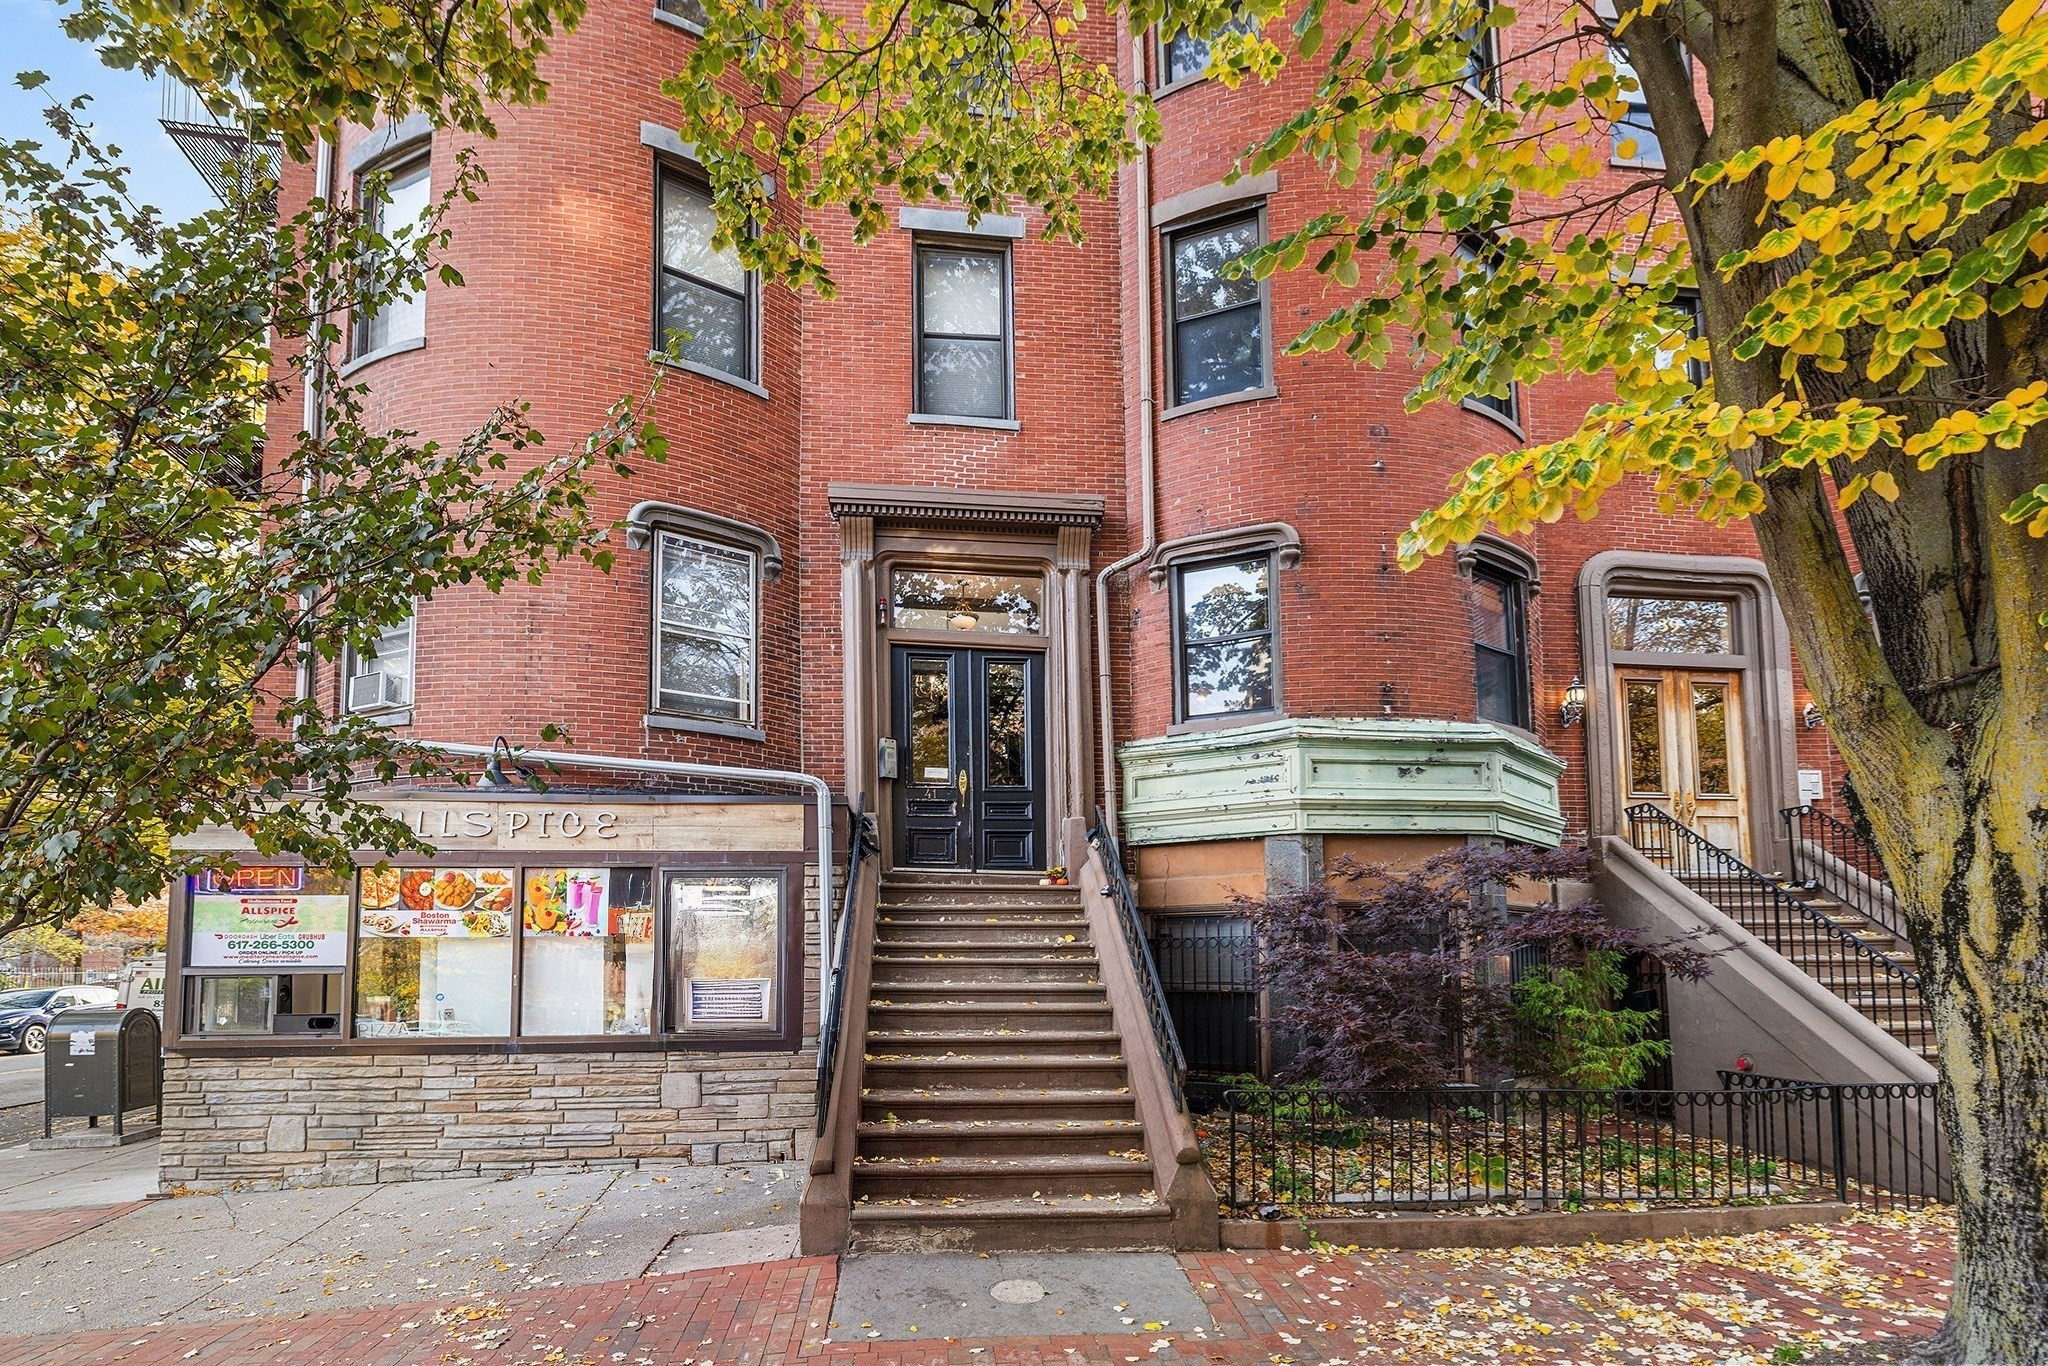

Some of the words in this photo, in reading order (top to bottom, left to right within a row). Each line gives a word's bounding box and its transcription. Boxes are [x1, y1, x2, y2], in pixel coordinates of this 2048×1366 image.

[924, 789, 937, 799] 41
[395, 810, 618, 838] LLSPICE
[241, 906, 296, 915] ALLSPICE
[412, 917, 457, 925] Shawarma
[228, 941, 315, 950] 617-266-5300
[358, 1022, 409, 1038] PIZZA
